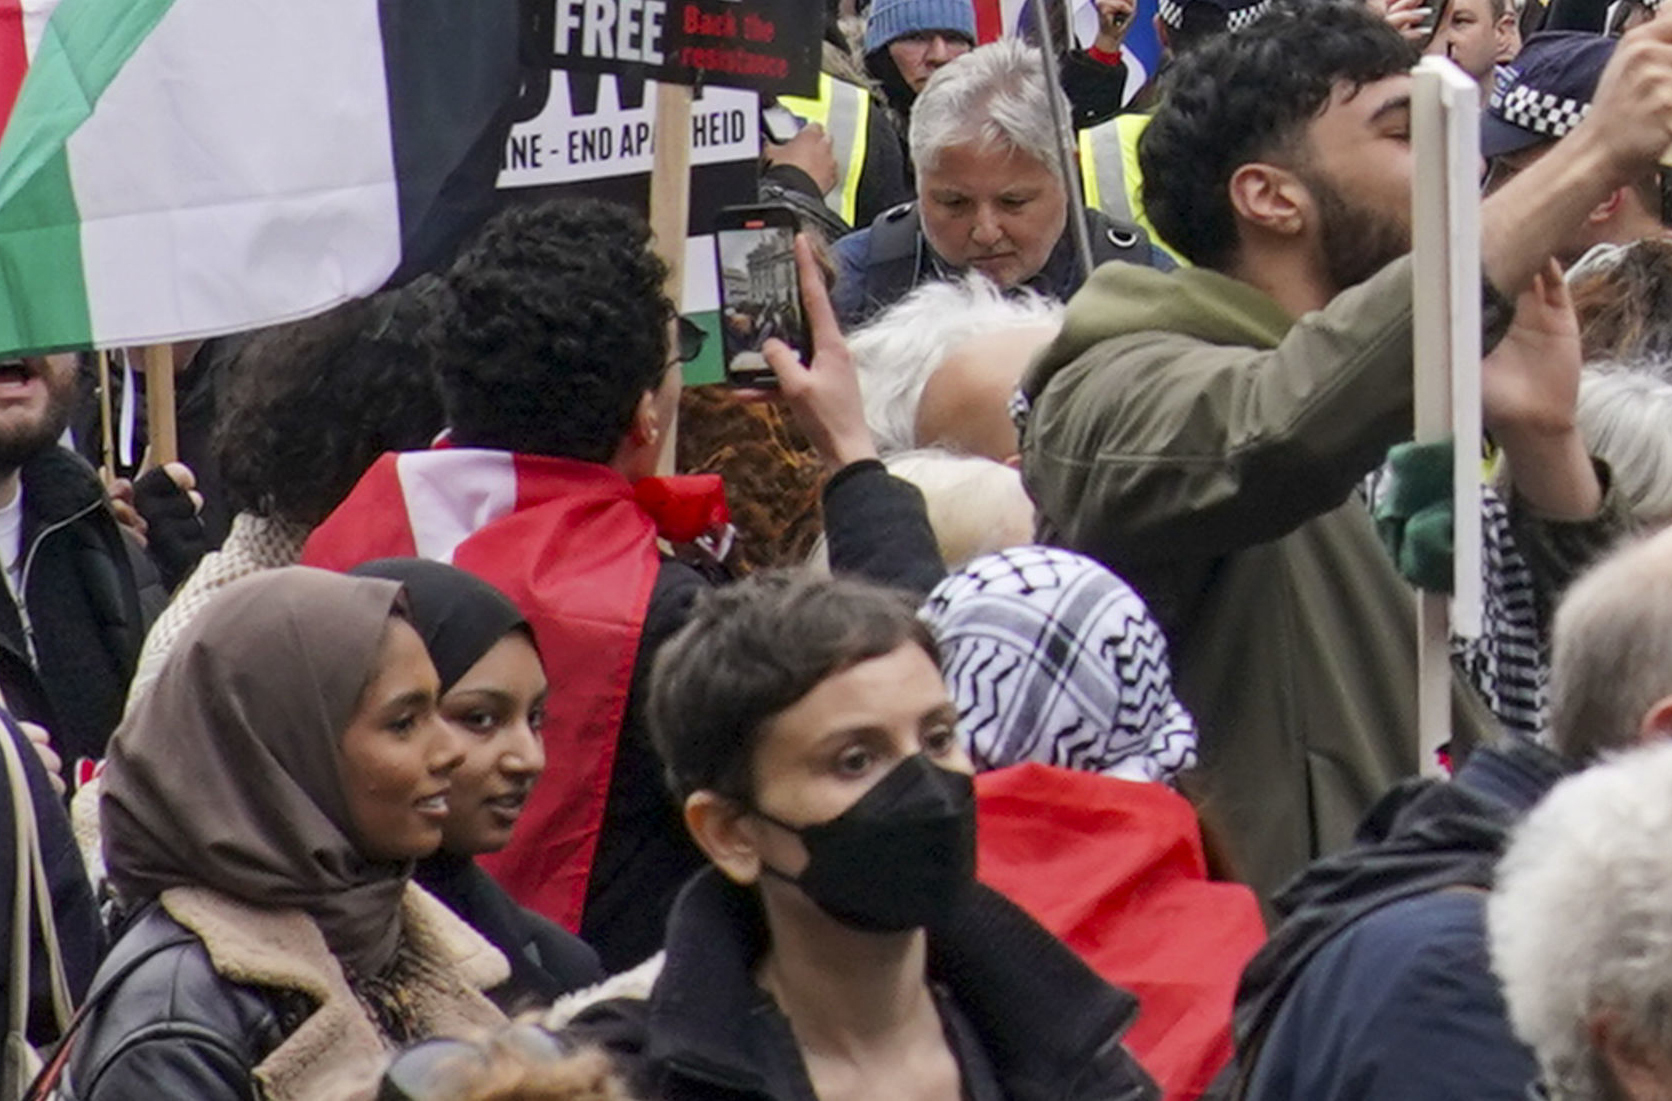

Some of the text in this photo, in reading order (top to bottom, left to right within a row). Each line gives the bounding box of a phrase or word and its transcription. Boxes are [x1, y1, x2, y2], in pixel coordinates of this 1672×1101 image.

[503, 134, 542, 170] NE
[568, 127, 614, 165] END
[619, 109, 745, 158] APHEID
